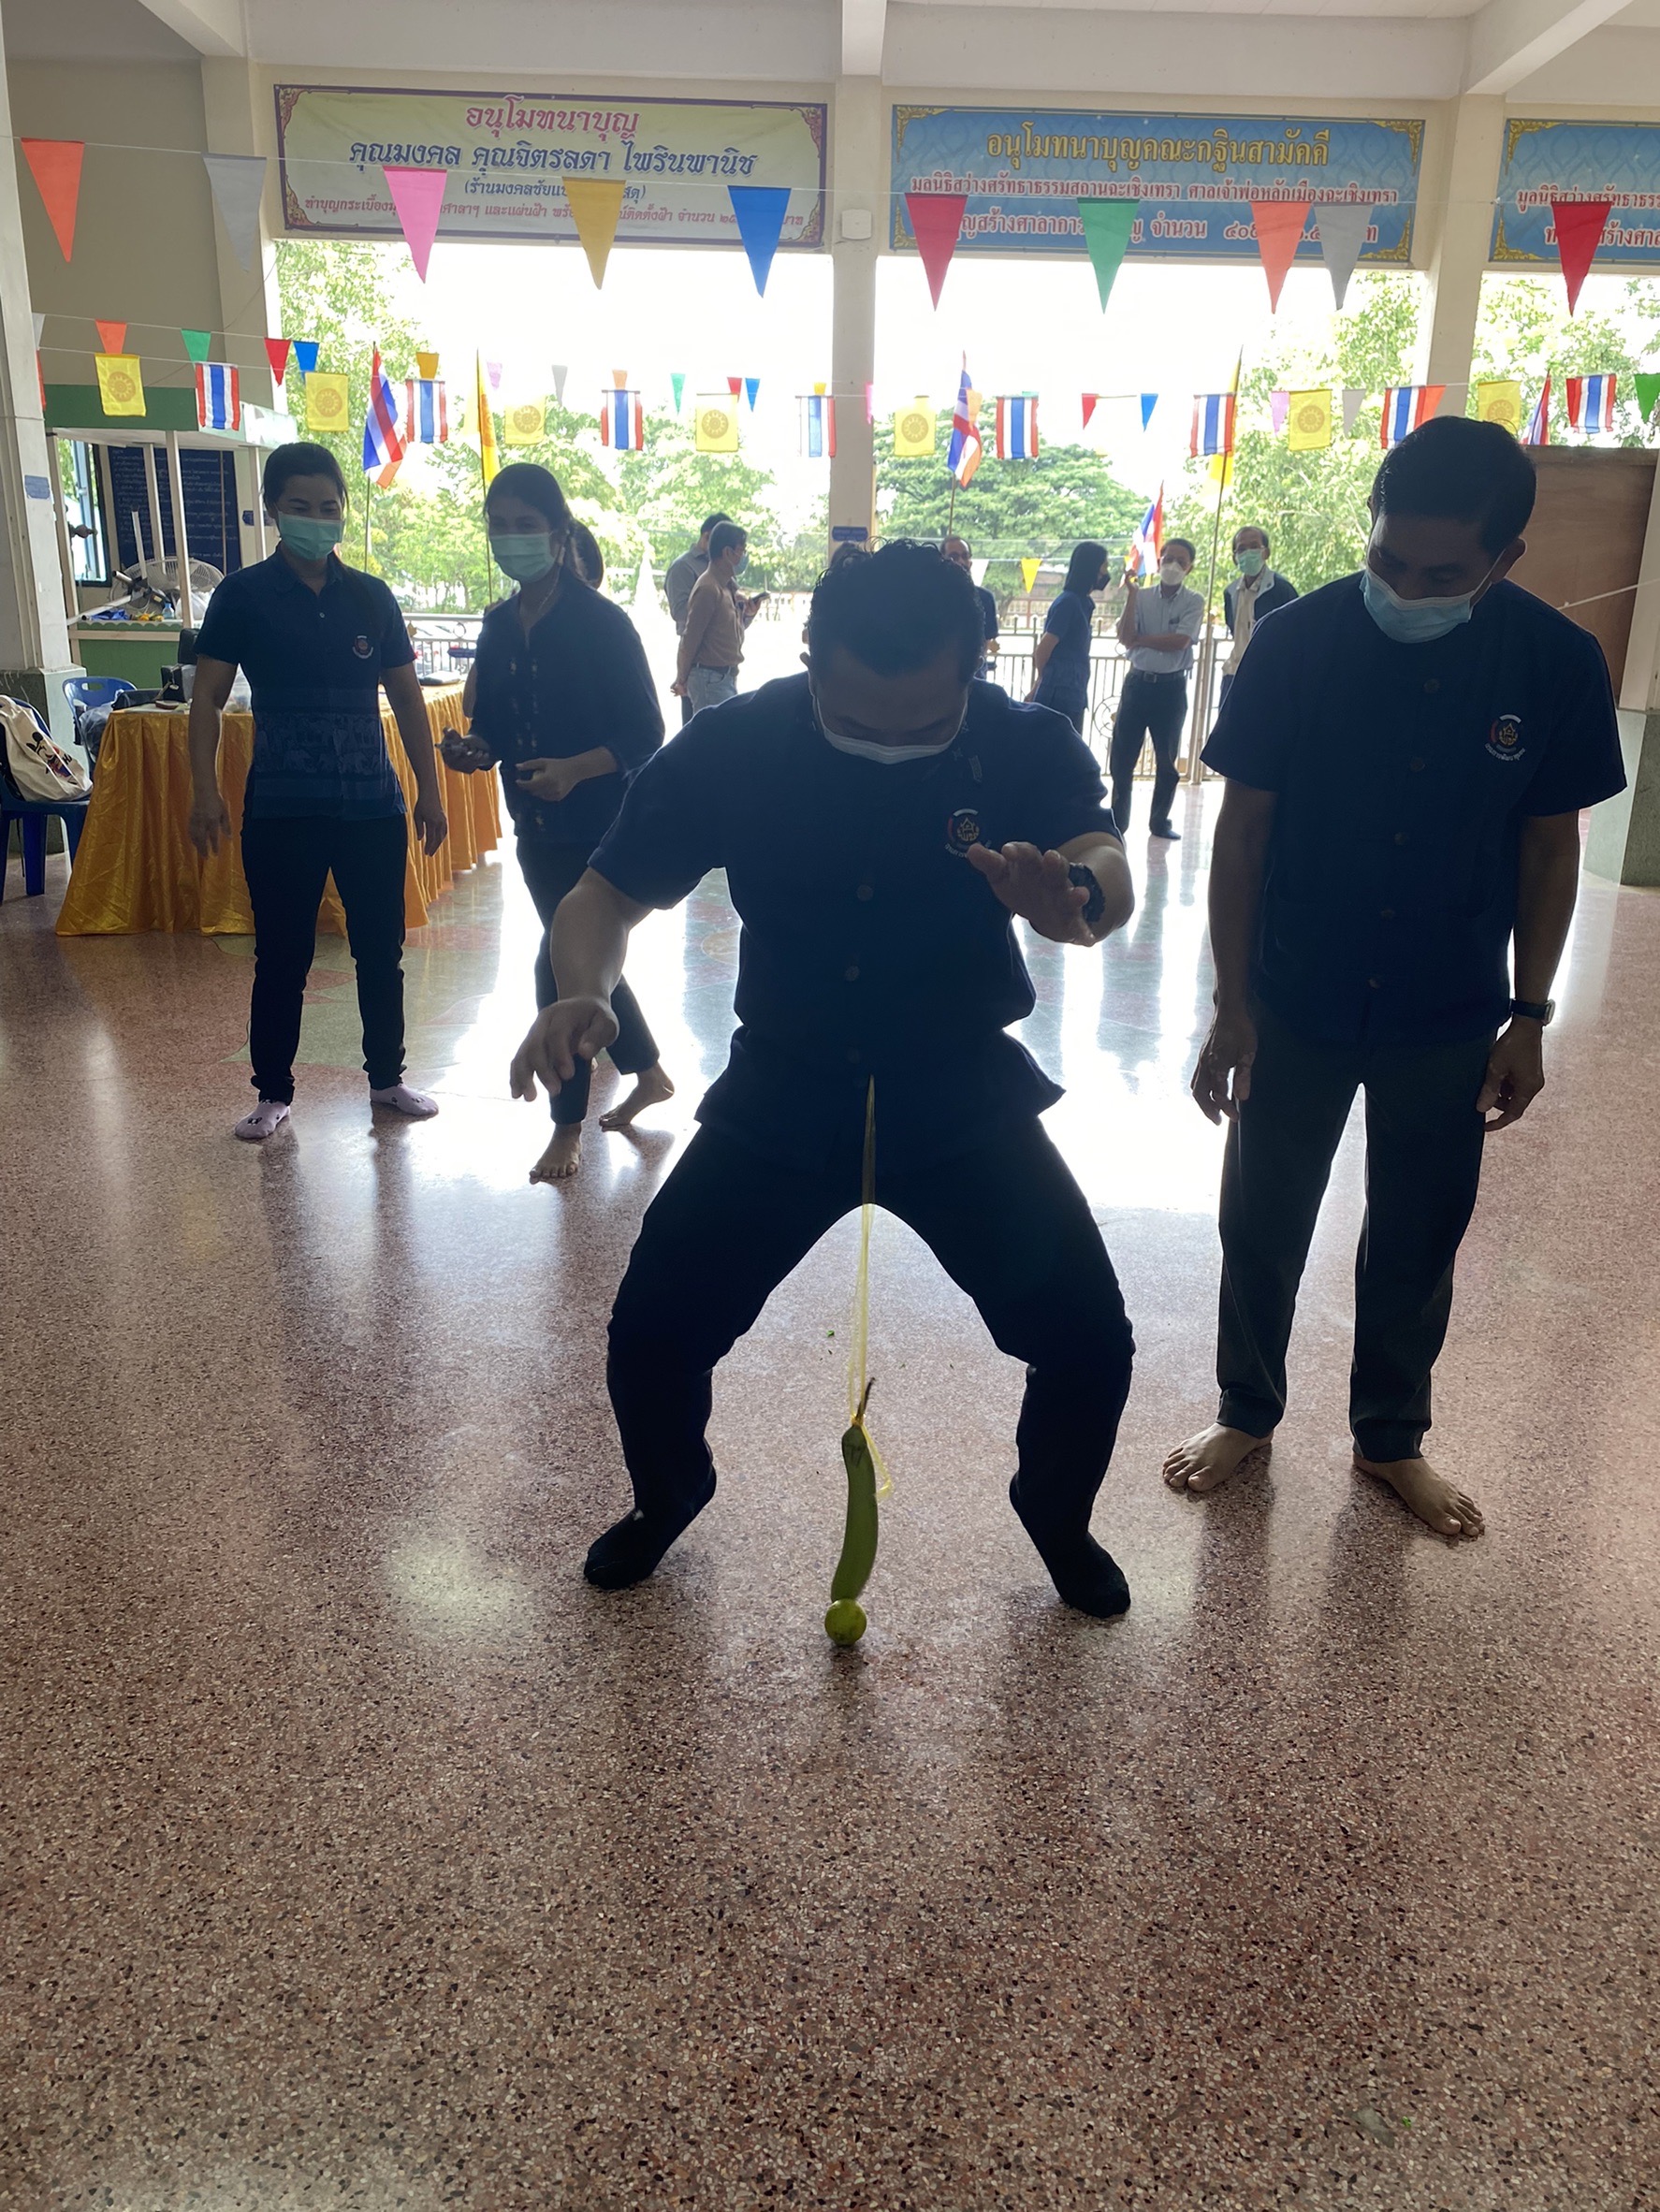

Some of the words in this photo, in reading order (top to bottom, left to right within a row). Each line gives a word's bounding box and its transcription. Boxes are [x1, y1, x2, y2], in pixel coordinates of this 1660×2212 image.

[466, 95, 640, 141] อนุโมทนาบุญ
[350, 142, 461, 172] คุณมงคล
[471, 140, 611, 176] คุณจิตรลดา
[987, 122, 1330, 172] อนุโมทนาบุญคณะกฐินสามัคคี
[678, 208, 715, 224] จำนวน
[1151, 210, 1207, 239] จำนวน
